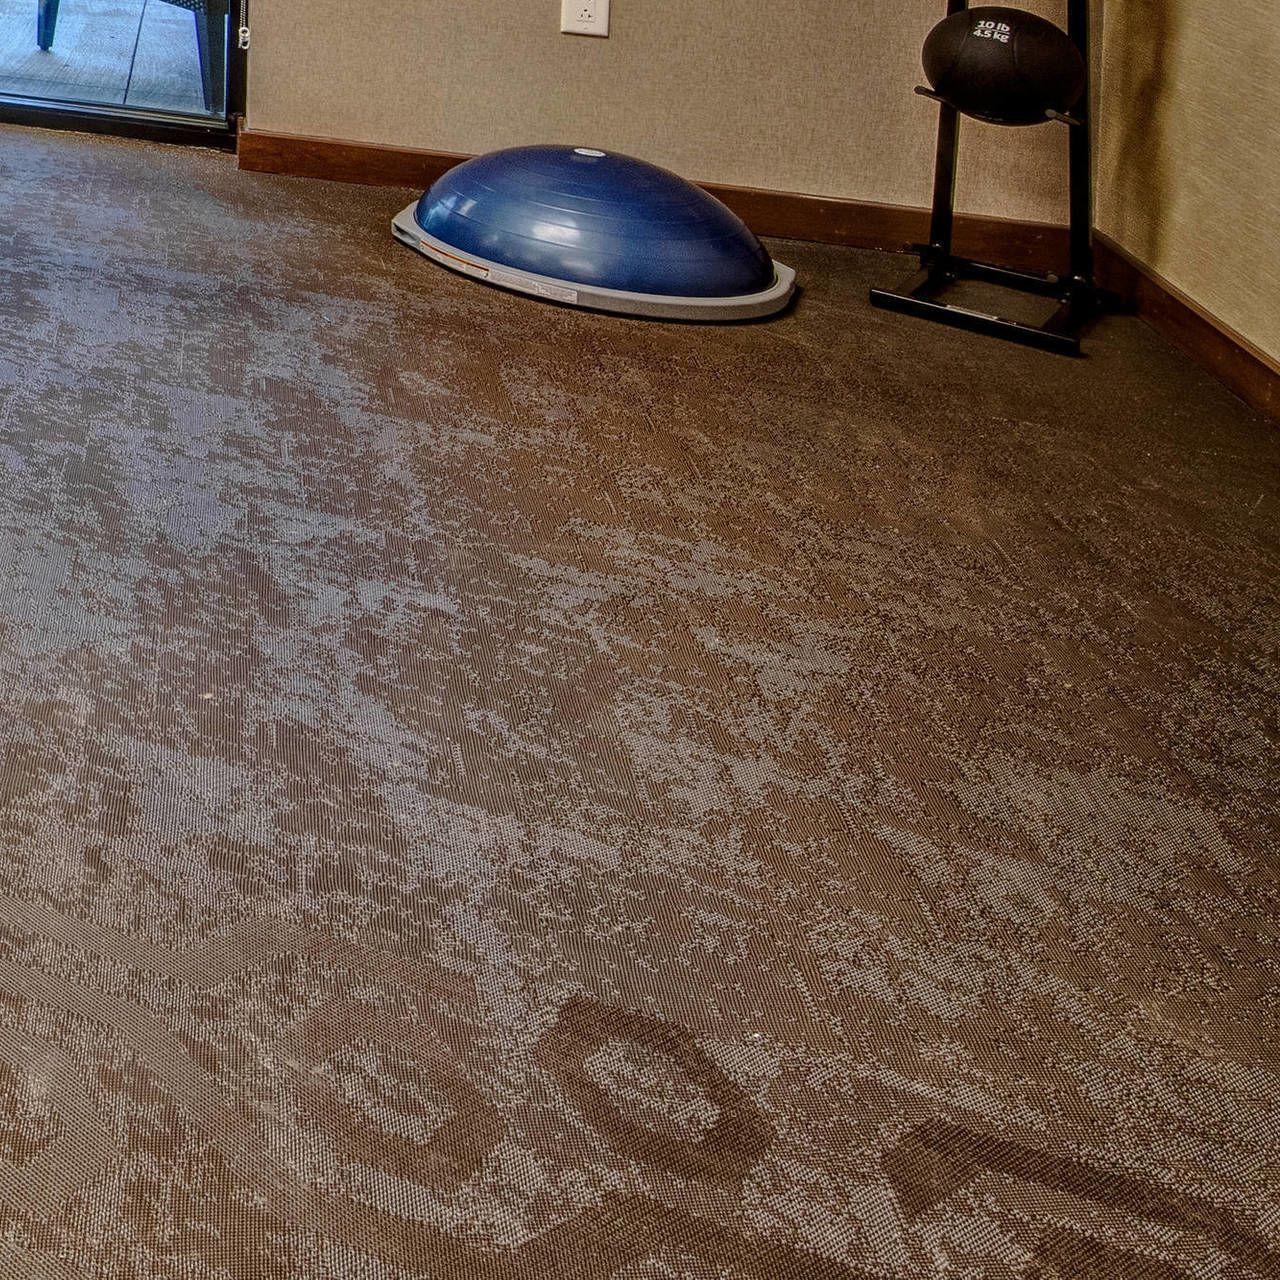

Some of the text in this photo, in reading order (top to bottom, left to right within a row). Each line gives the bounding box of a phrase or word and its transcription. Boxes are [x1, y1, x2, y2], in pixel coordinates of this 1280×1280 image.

[977, 20, 1010, 32] 10 lb
[973, 29, 1010, 44] 4.5 kg
